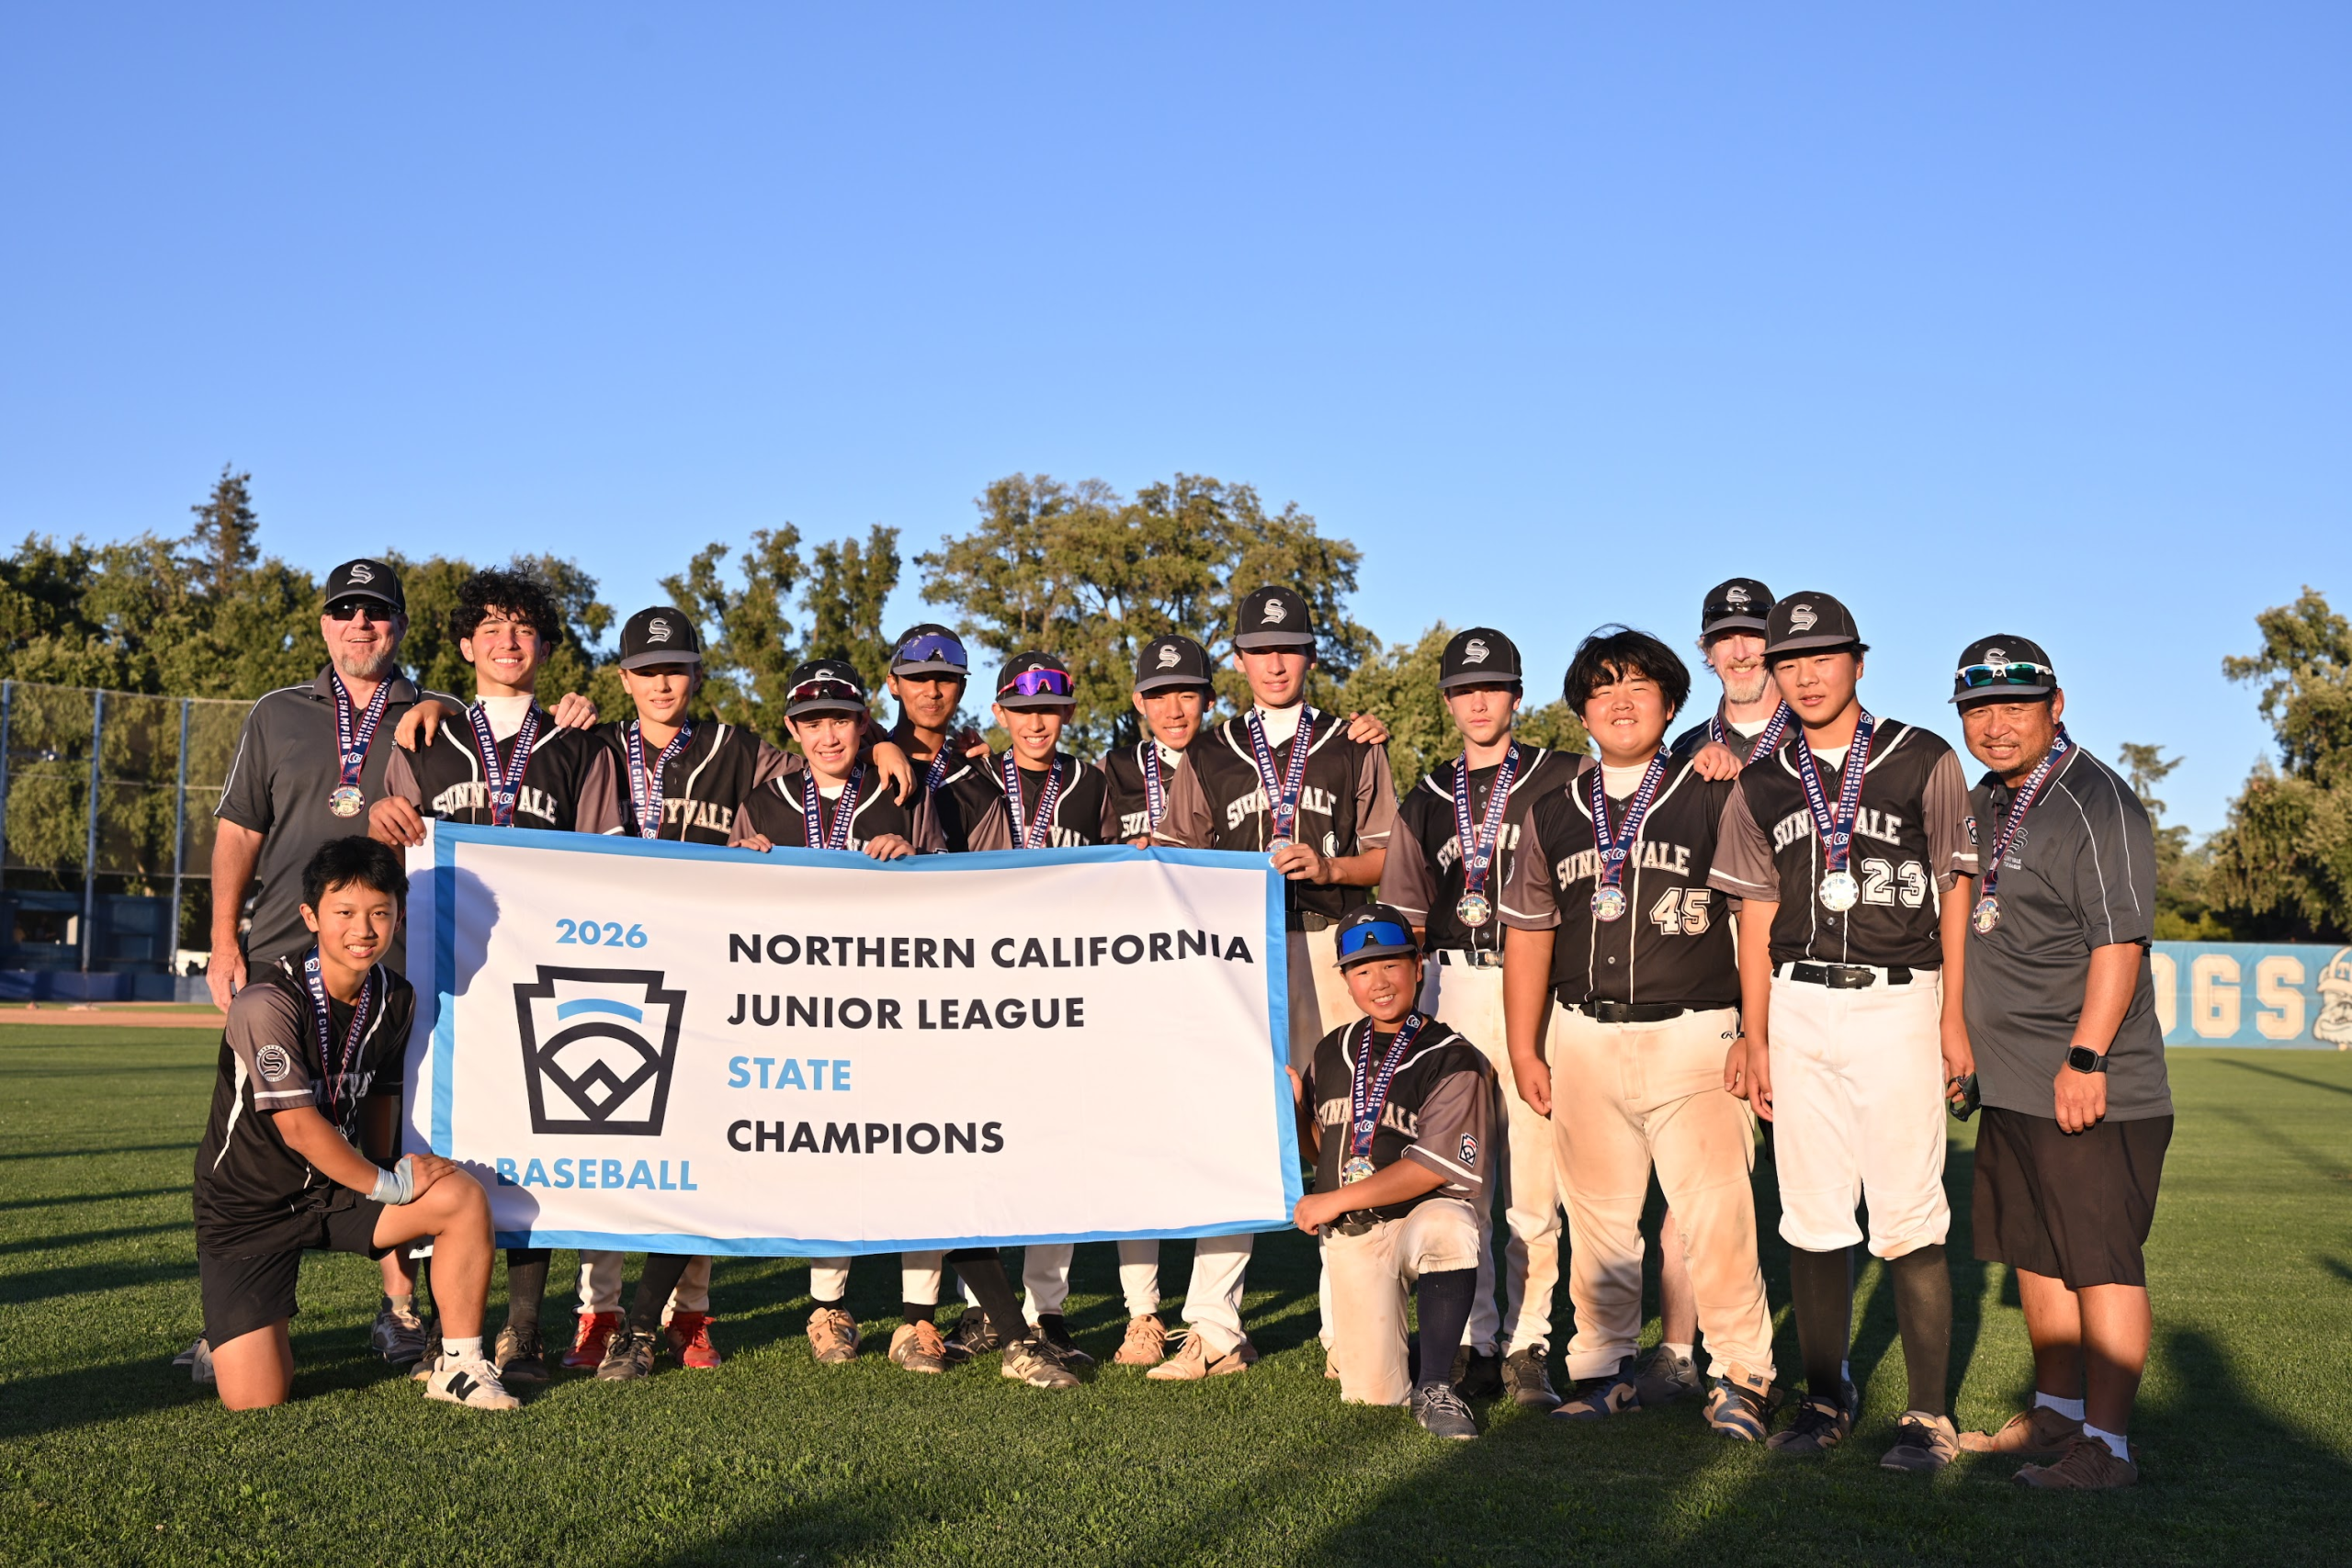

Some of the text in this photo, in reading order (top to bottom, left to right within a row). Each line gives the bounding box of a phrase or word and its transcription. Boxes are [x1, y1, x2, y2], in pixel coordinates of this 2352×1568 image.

[347, 564, 375, 584] S
[647, 617, 673, 644] S
[1261, 598, 1287, 624] S
[1788, 604, 1817, 635] S
[1156, 644, 1181, 670] S
[1462, 638, 1489, 665] S
[339, 699, 352, 750] CHAMPION
[354, 711, 373, 747] NORTHERN
[363, 722, 376, 742] STATE
[473, 710, 502, 786] STATE CHAMPION
[504, 712, 535, 786] NORTHERN CALIFORNIA
[514, 719, 538, 782] STATE TOURNAMENT
[630, 734, 641, 766] STATE
[926, 753, 943, 784] ALIFORNIA
[1147, 750, 1156, 779] STATE
[1251, 721, 1281, 803] STATE CHAMPION
[1283, 717, 1306, 796] NORTHERN CALIFORNIA
[1292, 724, 1312, 792] STATE TOURNAMENT
[1749, 738, 1769, 764] THERN
[646, 777, 659, 820] NORTHERN
[655, 739, 680, 778] CALIFORNIA
[930, 761, 946, 792] URNAMENT
[1005, 762, 1018, 794] STATE
[1619, 759, 1660, 841] NORTHERN CALIFORNIA
[1628, 765, 1665, 837] STATE TOURNAMENT
[1798, 739, 1832, 830] STATE CHAMPION
[1838, 729, 1863, 824] NORTHERN CALIFORNIA
[1847, 737, 1870, 818] STATE TOURNAMENT
[2017, 763, 2051, 817] TOURNAMENT
[2018, 756, 2049, 802] CALIFORNIA
[432, 782, 558, 825] SUNNALE
[806, 782, 820, 849] STATE CHAMP
[829, 783, 853, 849] THERN CALIFORNIA
[840, 790, 857, 835] TOURNAMENT
[1027, 774, 1056, 849] ORTHERN CALIFORNIA
[1043, 782, 1059, 827] TOURNAMENT
[1456, 765, 1474, 855] STATE CHAMPION
[1478, 762, 1510, 849] NORTHERN CALIFORNIA
[1487, 770, 1515, 844] STATE TOURNAMENT
[1593, 794, 1610, 846] CHAMPION
[1556, 841, 1690, 892] SUNNVALE
[1860, 858, 1928, 908] 23
[557, 919, 648, 948] 2026
[1649, 886, 1712, 936] 45
[729, 929, 1254, 968] NORTHERN CALIFORNIA
[309, 976, 328, 1064] STATE CHAMP
[728, 993, 1084, 1030] JUNIOR LEAGUE
[729, 1056, 851, 1090] STATE
[1354, 1030, 1371, 1117] STATE CHAMPION
[1366, 1031, 1407, 1112] NORTHERN CALIFORNIA
[1375, 1038, 1410, 1108] STATE TOURNAMENT
[727, 1120, 1003, 1155] CHAMPIONS
[496, 1158, 698, 1190] BASEBALL
